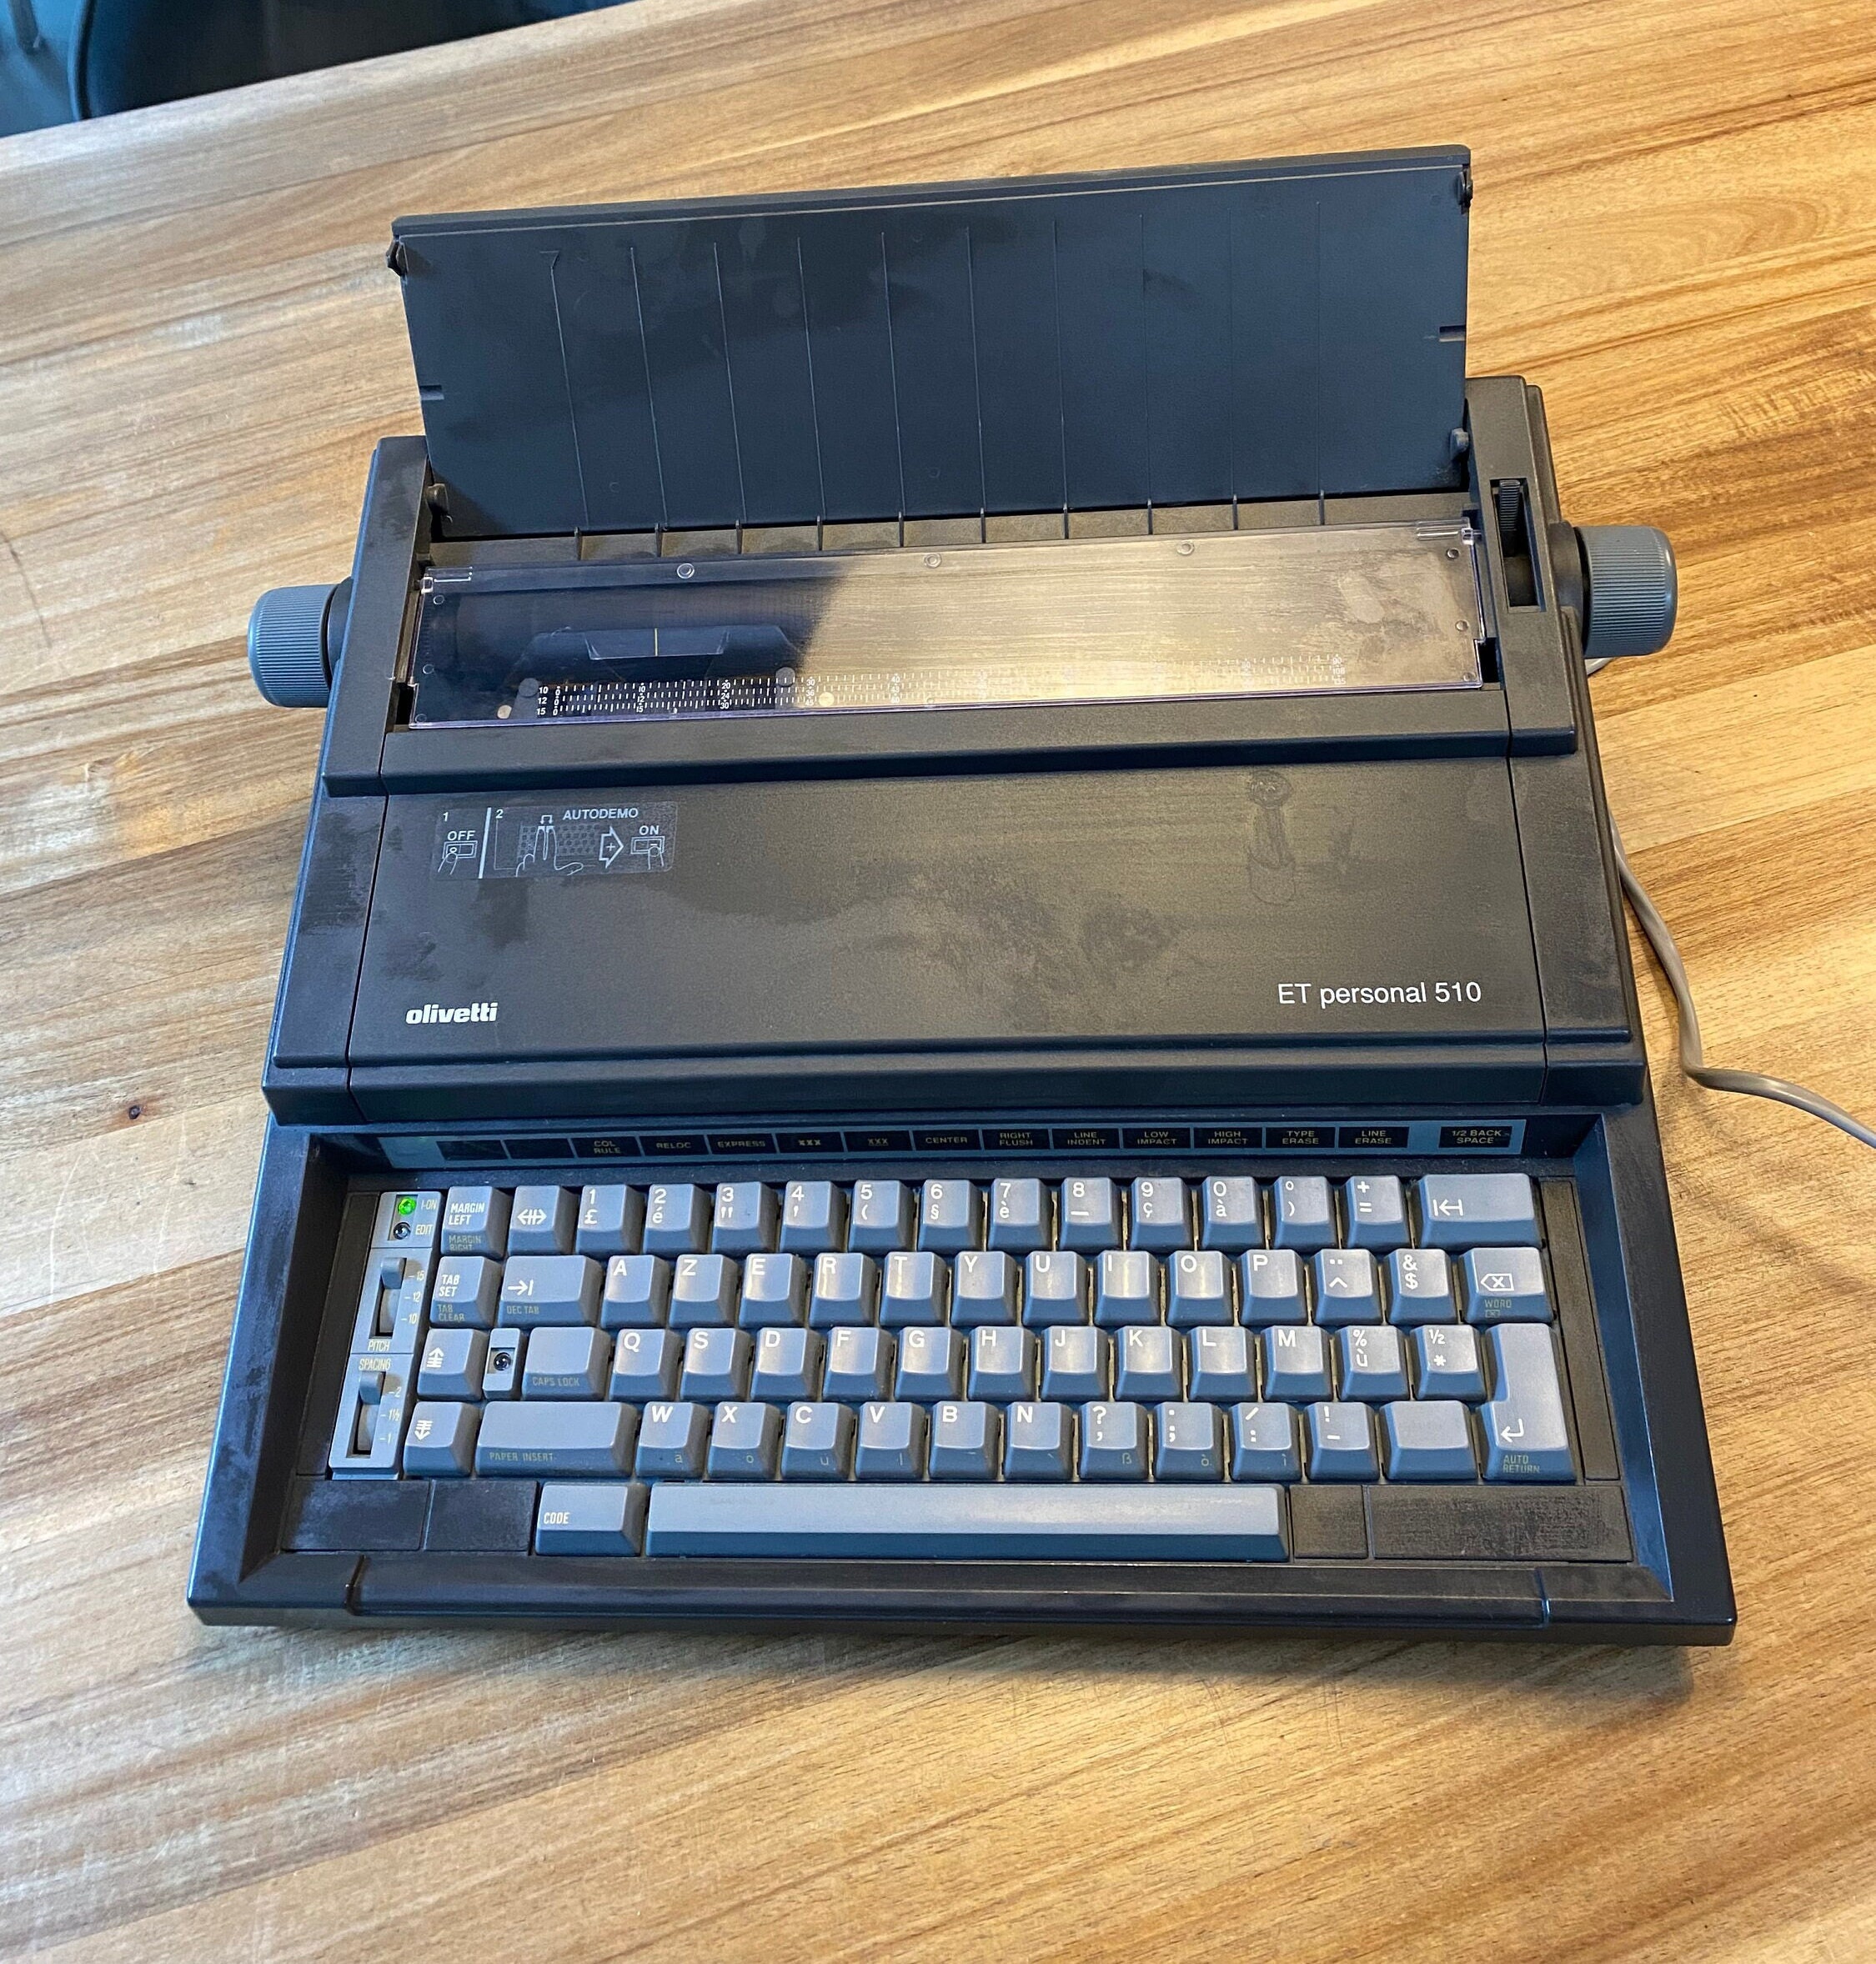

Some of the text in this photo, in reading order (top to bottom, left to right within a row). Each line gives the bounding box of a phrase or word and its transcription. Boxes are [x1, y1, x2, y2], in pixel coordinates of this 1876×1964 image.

[443, 813, 449, 822] 1
[495, 809, 504, 819] 2
[563, 807, 639, 820] AUTODEMO
[447, 830, 475, 841] OFF
[639, 825, 660, 835] ON
[1278, 981, 1482, 1009] ET personal 510
[405, 1003, 498, 1025] olivetti
[656, 1141, 691, 1150] RELOC
[718, 1140, 766, 1148] EXPRESS
[589, 1190, 595, 1204] 1
[653, 1190, 667, 1204] 2
[722, 1187, 735, 1202] 3
[791, 1185, 804, 1200] 4
[861, 1185, 872, 1200] 5
[930, 1184, 943, 1200] 6
[1000, 1184, 1011, 1199] 7
[1072, 1182, 1085, 1198] 8
[1141, 1182, 1154, 1197] 9
[450, 1203, 485, 1213] MARGIN
[449, 1214, 472, 1225] LEFT
[415, 1225, 434, 1235] EDIT
[449, 1235, 481, 1244] MARGIN
[613, 1260, 627, 1276] A
[682, 1259, 698, 1276] Z
[751, 1259, 765, 1275] E
[821, 1257, 836, 1275] R
[894, 1256, 907, 1274] T
[964, 1256, 978, 1273] Y
[1036, 1255, 1051, 1273] U
[1253, 1255, 1268, 1271] P
[1402, 1255, 1417, 1271] &
[442, 1275, 459, 1285] TAB
[1406, 1272, 1418, 1290] $
[439, 1286, 458, 1297] SET
[438, 1304, 453, 1313] TAB
[506, 1305, 540, 1315] DEC TAB
[1484, 1299, 1512, 1309] WORD
[439, 1313, 465, 1321] CLEAR
[368, 1340, 389, 1351] PITCH
[624, 1332, 640, 1353] Q
[694, 1332, 709, 1350] S
[765, 1330, 781, 1348] D
[837, 1330, 851, 1347] F
[908, 1330, 925, 1348] G
[981, 1330, 997, 1346] H
[1055, 1330, 1066, 1347] J
[1129, 1330, 1143, 1346] K
[1202, 1330, 1216, 1346] L
[1278, 1330, 1297, 1347] M
[1352, 1329, 1367, 1347] %
[359, 1358, 391, 1371] SPACING
[533, 1376, 580, 1386] CAPS LOCK
[651, 1405, 673, 1423] W
[721, 1405, 738, 1423] X
[795, 1405, 812, 1424] C
[870, 1405, 885, 1423] V
[942, 1405, 958, 1423] B
[1016, 1405, 1033, 1423] N
[1092, 1405, 1107, 1425] ?
[489, 1452, 554, 1461] PAPER INSERT
[1503, 1455, 1528, 1465] AUTO
[1502, 1465, 1540, 1475] RETURN
[544, 1511, 569, 1526] CODE
